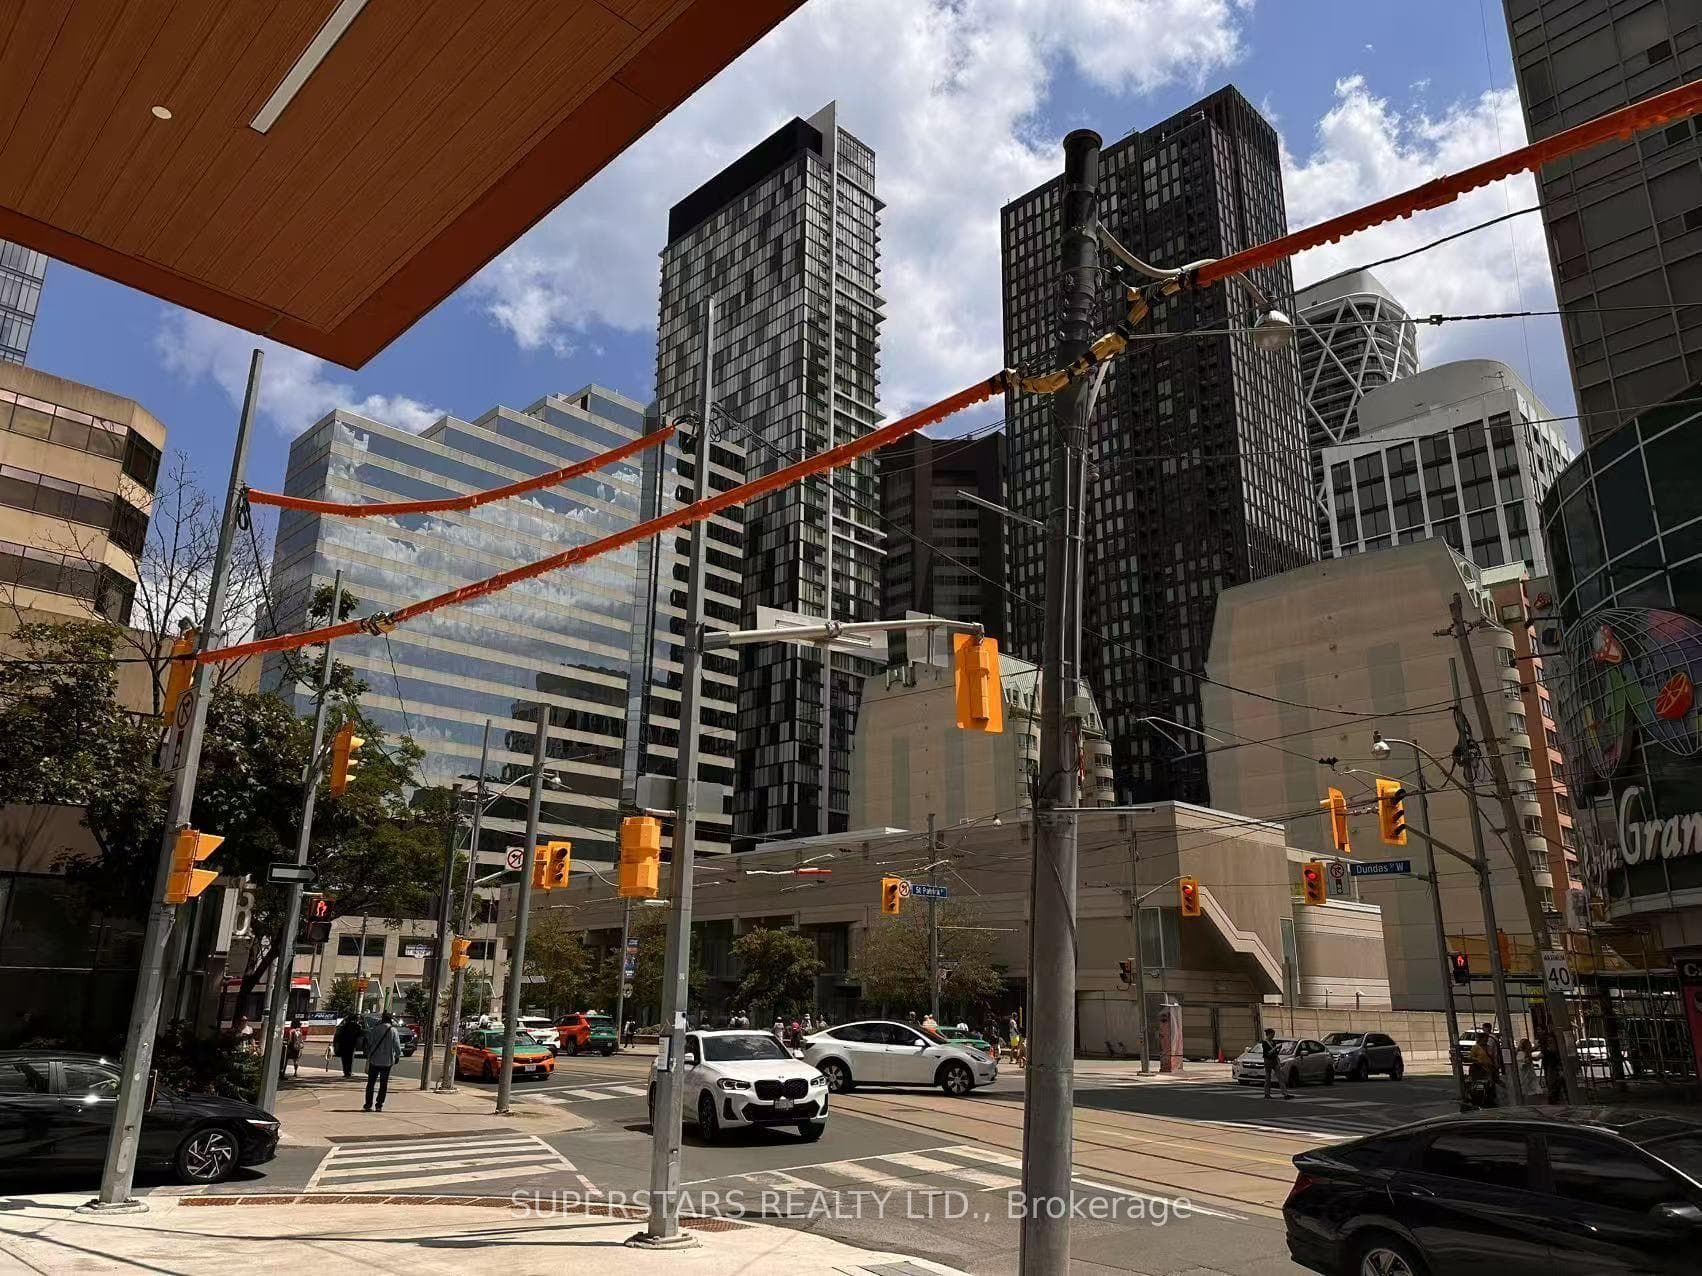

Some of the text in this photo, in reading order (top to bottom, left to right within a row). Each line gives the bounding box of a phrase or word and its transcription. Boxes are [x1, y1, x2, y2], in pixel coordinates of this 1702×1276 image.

[1356, 864, 1388, 873] Dundas
[1396, 862, 1404, 871] W
[1548, 967, 1570, 986] 40
